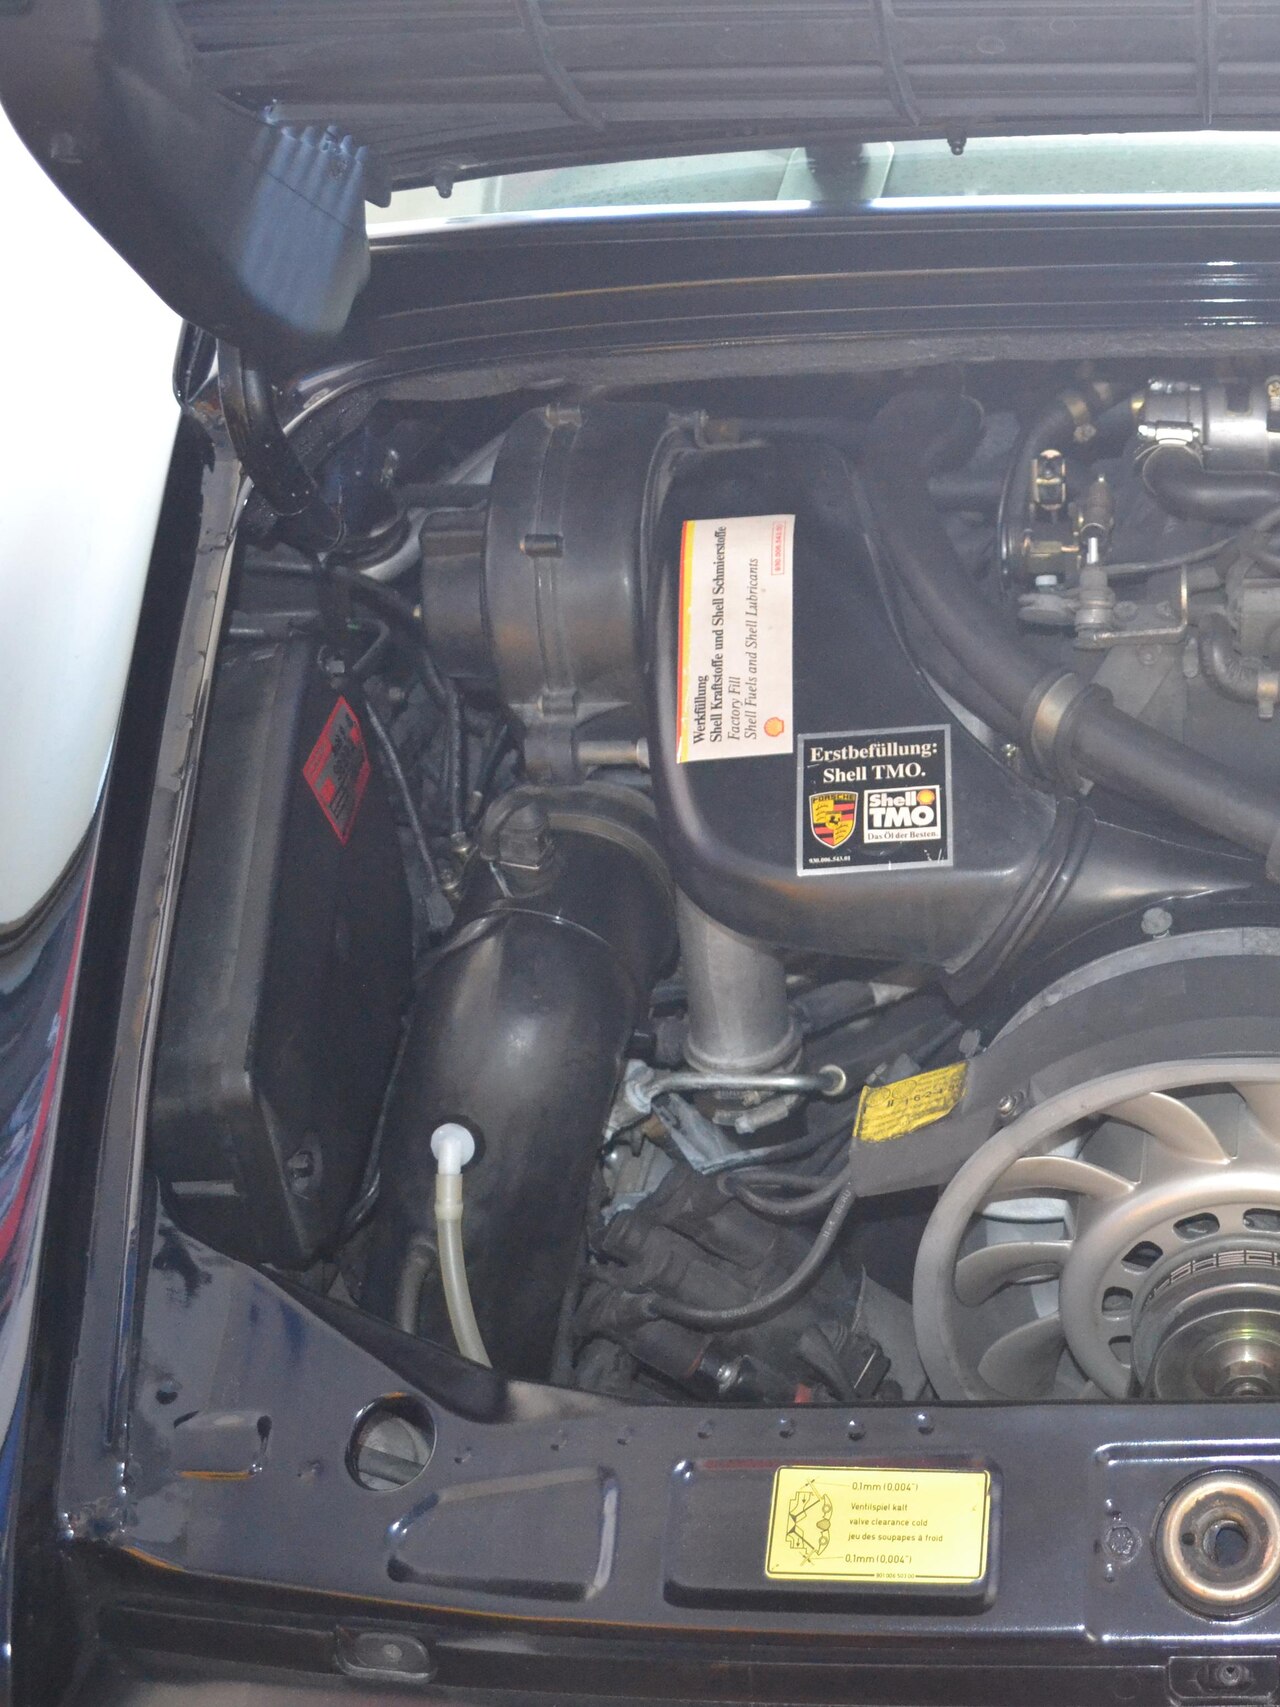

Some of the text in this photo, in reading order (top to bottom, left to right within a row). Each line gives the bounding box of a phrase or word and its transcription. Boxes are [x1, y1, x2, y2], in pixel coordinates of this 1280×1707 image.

[710, 527, 726, 743] Shell Kraftstoffe und Shell Schmierstoffe
[745, 558, 759, 739] Shell Fuels and Shell Lubricants
[693, 675, 708, 744] Werkfüllung
[728, 676, 743, 741] Factory Fill
[810, 739, 937, 765] Erstbefüllung:
[823, 762, 925, 783] Shell TMO.
[813, 793, 855, 803] PORSCHE
[869, 790, 917, 809] Shell
[869, 804, 934, 829] TMO
[868, 829, 938, 841] Das Öl der Besten.
[852, 1482, 881, 1491] 0,1mm
[850, 1503, 890, 1512] Ventilspiel
[848, 1533, 860, 1541] jeu
[878, 1534, 915, 1542] soupapes
[925, 1534, 943, 1542] froid
[845, 1554, 875, 1563] 0,1mm
